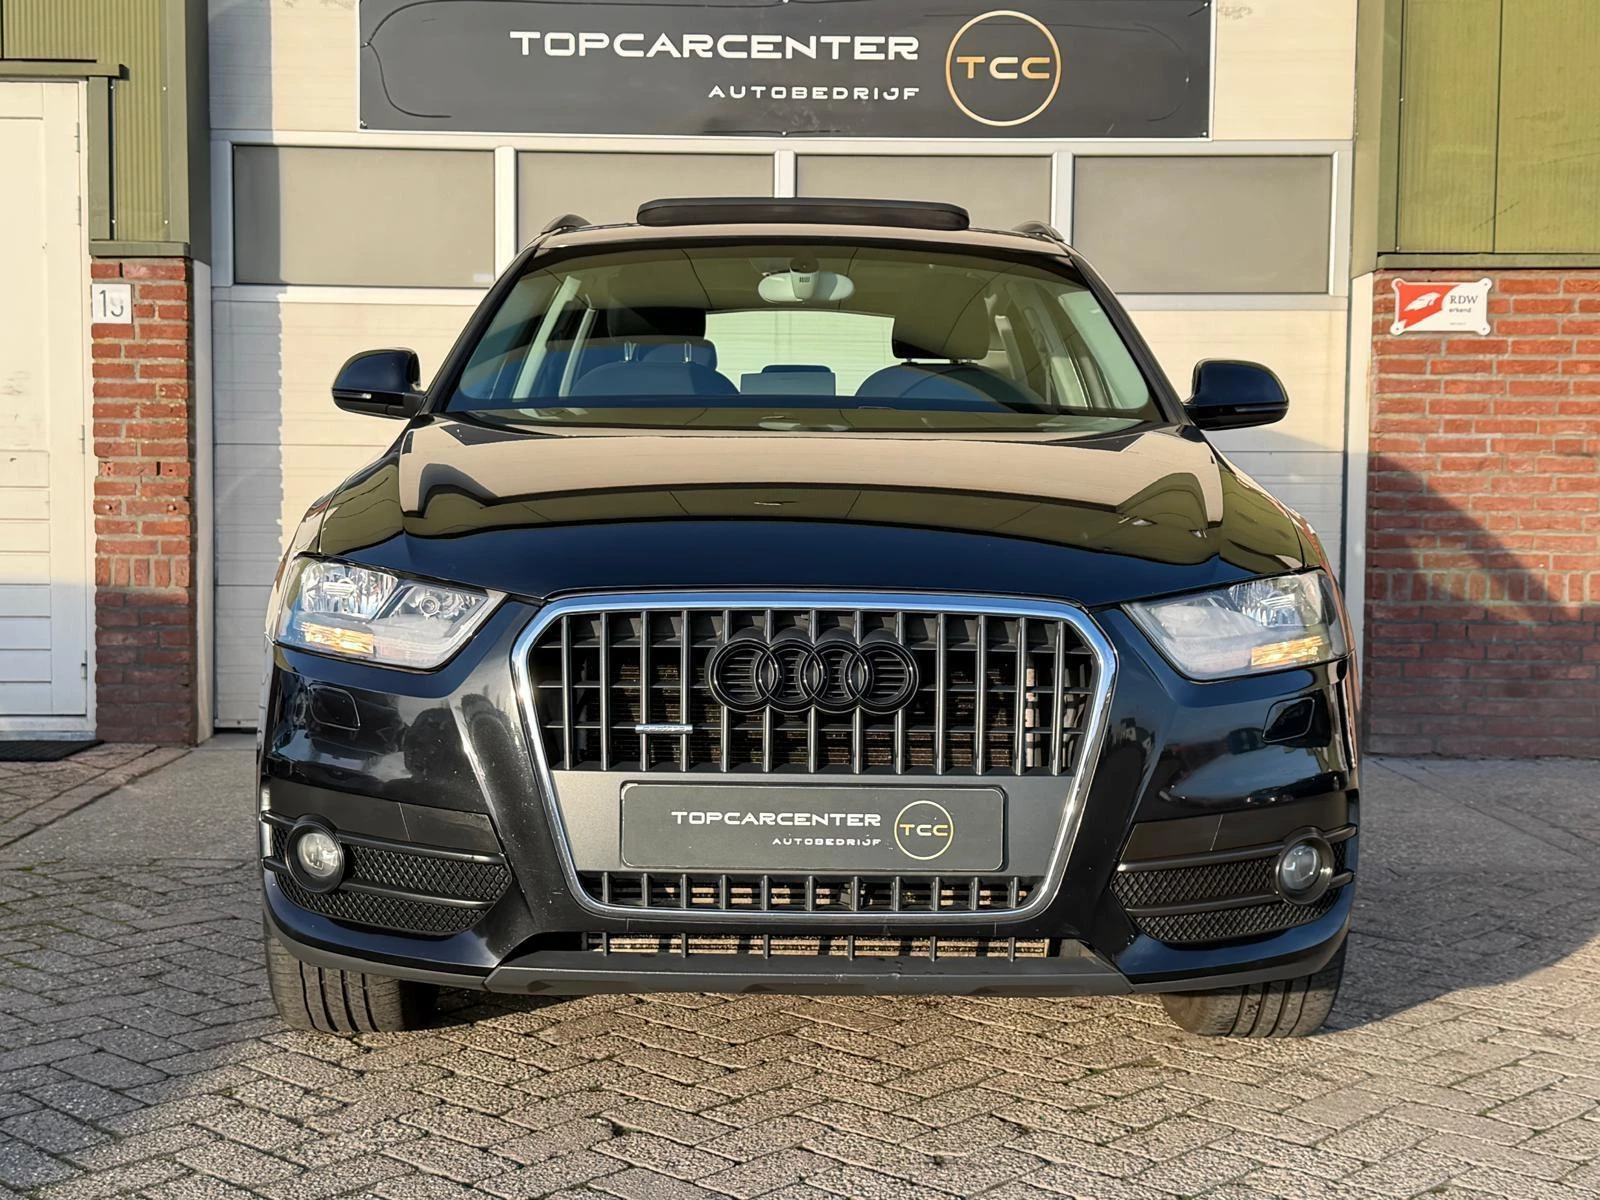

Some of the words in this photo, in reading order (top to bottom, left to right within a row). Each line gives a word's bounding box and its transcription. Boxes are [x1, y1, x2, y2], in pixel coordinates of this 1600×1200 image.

[509, 31, 919, 60] TOPCARCENTER
[956, 56, 1050, 79] TCC
[708, 85, 920, 101] AUTOBEDRIJF
[1449, 295, 1479, 305] RDW
[671, 811, 881, 827] TOPCARCENTER
[899, 824, 949, 837] TCC
[772, 837, 882, 847] AUTOBEDRIJF
